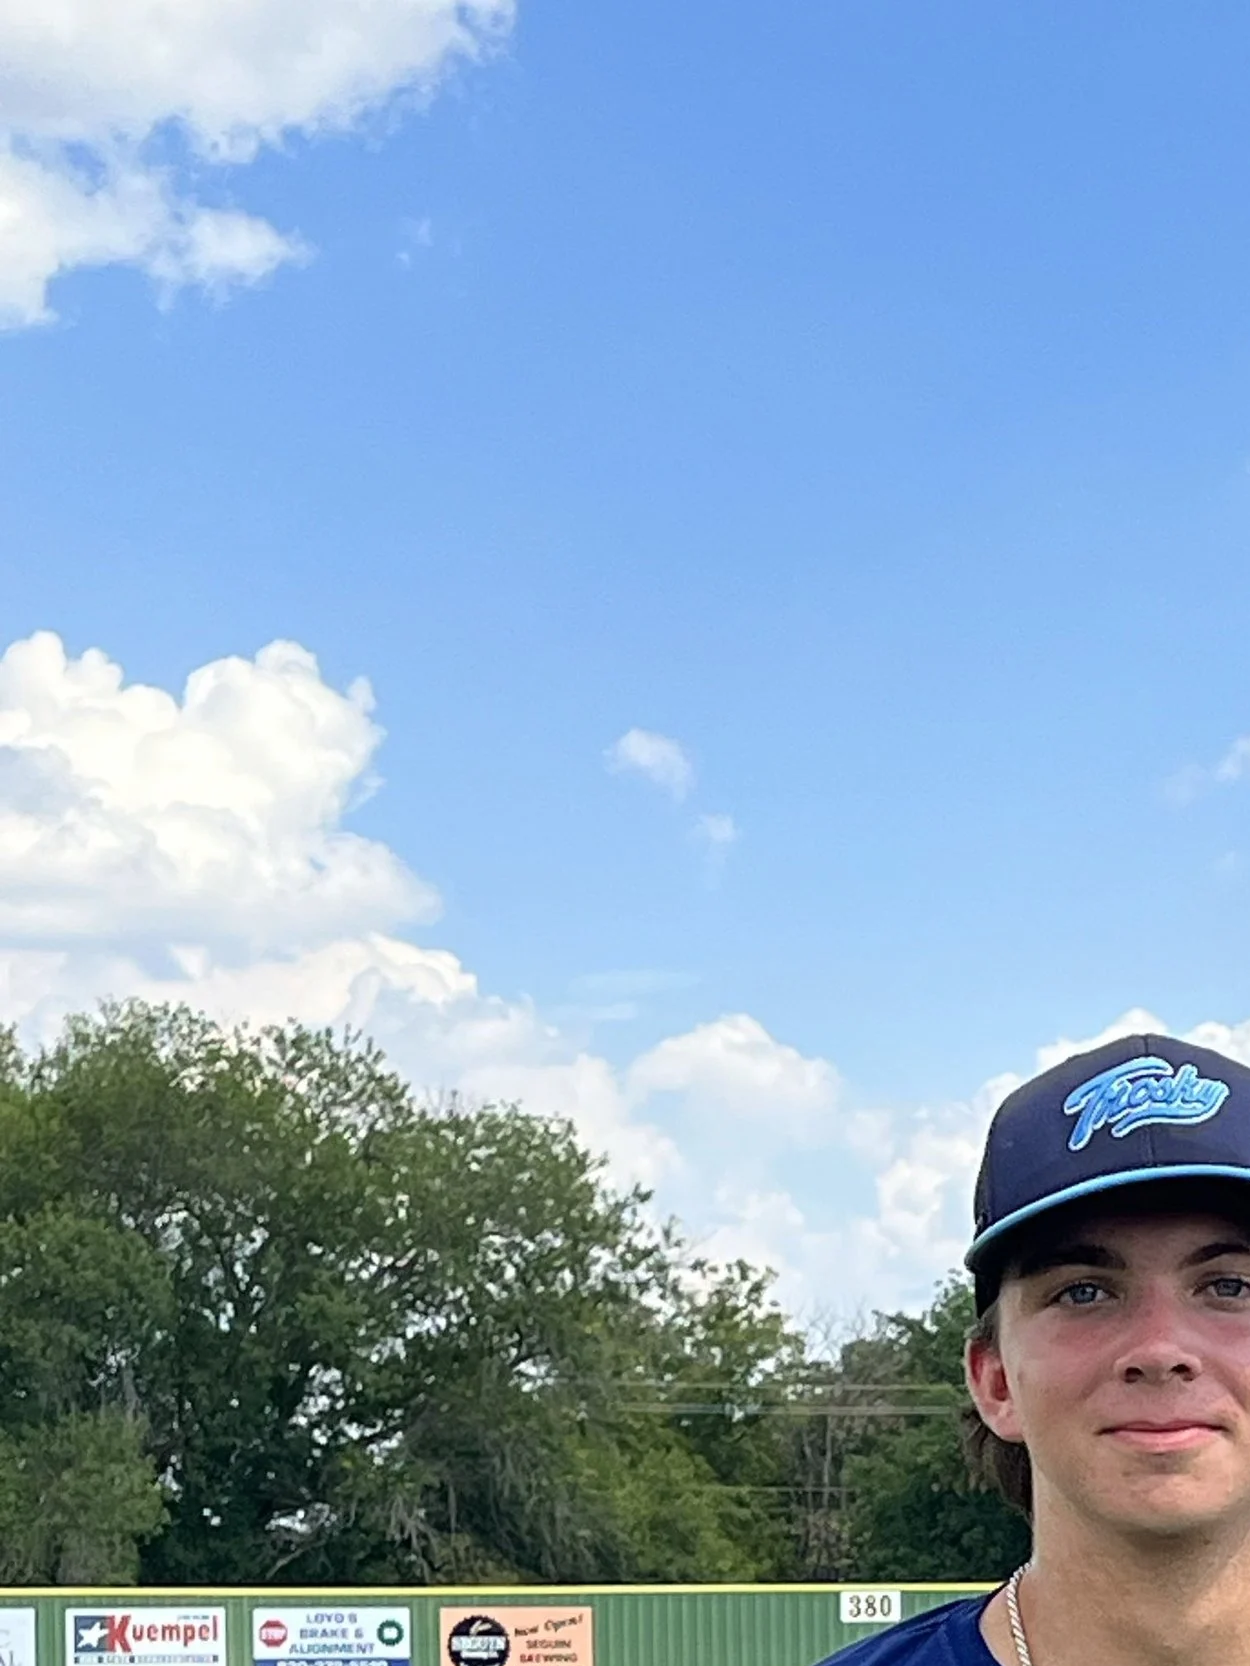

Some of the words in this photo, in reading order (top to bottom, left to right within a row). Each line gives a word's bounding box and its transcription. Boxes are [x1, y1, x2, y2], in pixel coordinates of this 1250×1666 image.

[1063, 1056, 1230, 1151] Trosky
[849, 1595, 892, 1618] 380
[107, 1614, 218, 1653] Kuempel
[299, 1628, 349, 1639] BRAKE
[289, 1643, 375, 1654] ALIGNMENT
[520, 1653, 578, 1663] BREWING
